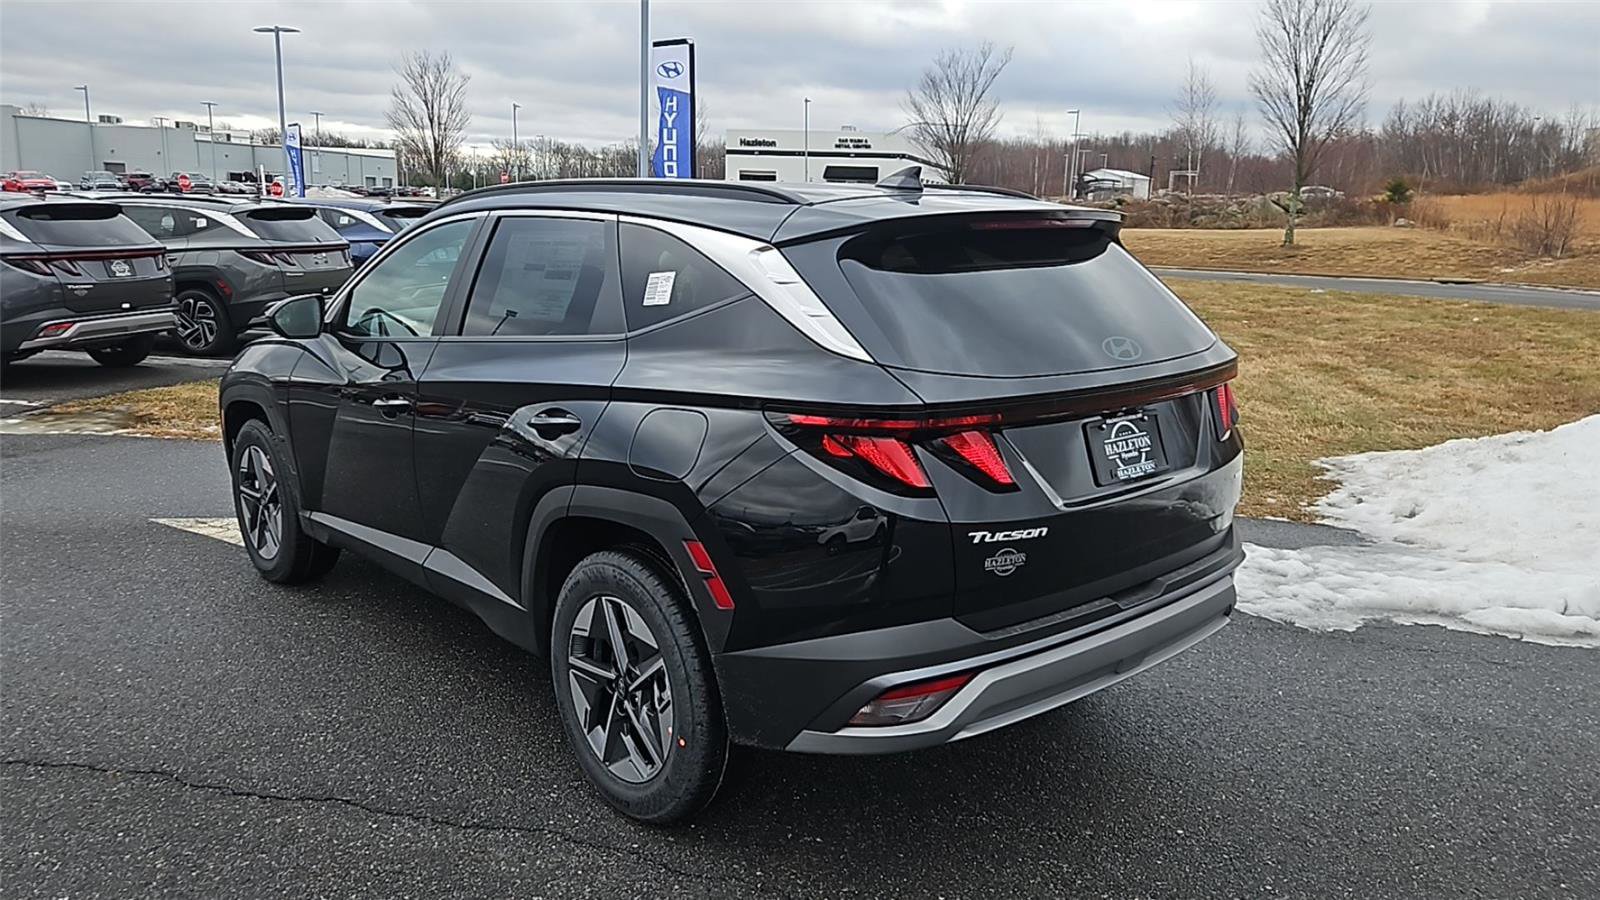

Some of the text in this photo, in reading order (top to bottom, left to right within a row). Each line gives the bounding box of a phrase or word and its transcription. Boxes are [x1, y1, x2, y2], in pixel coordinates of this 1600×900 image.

[663, 95, 678, 177] HYUND
[739, 138, 777, 148] Hazleton
[1104, 435, 1152, 456] HAZLETON
[1117, 461, 1157, 476] HAZLETON
[984, 552, 1027, 568] HAZLETON
